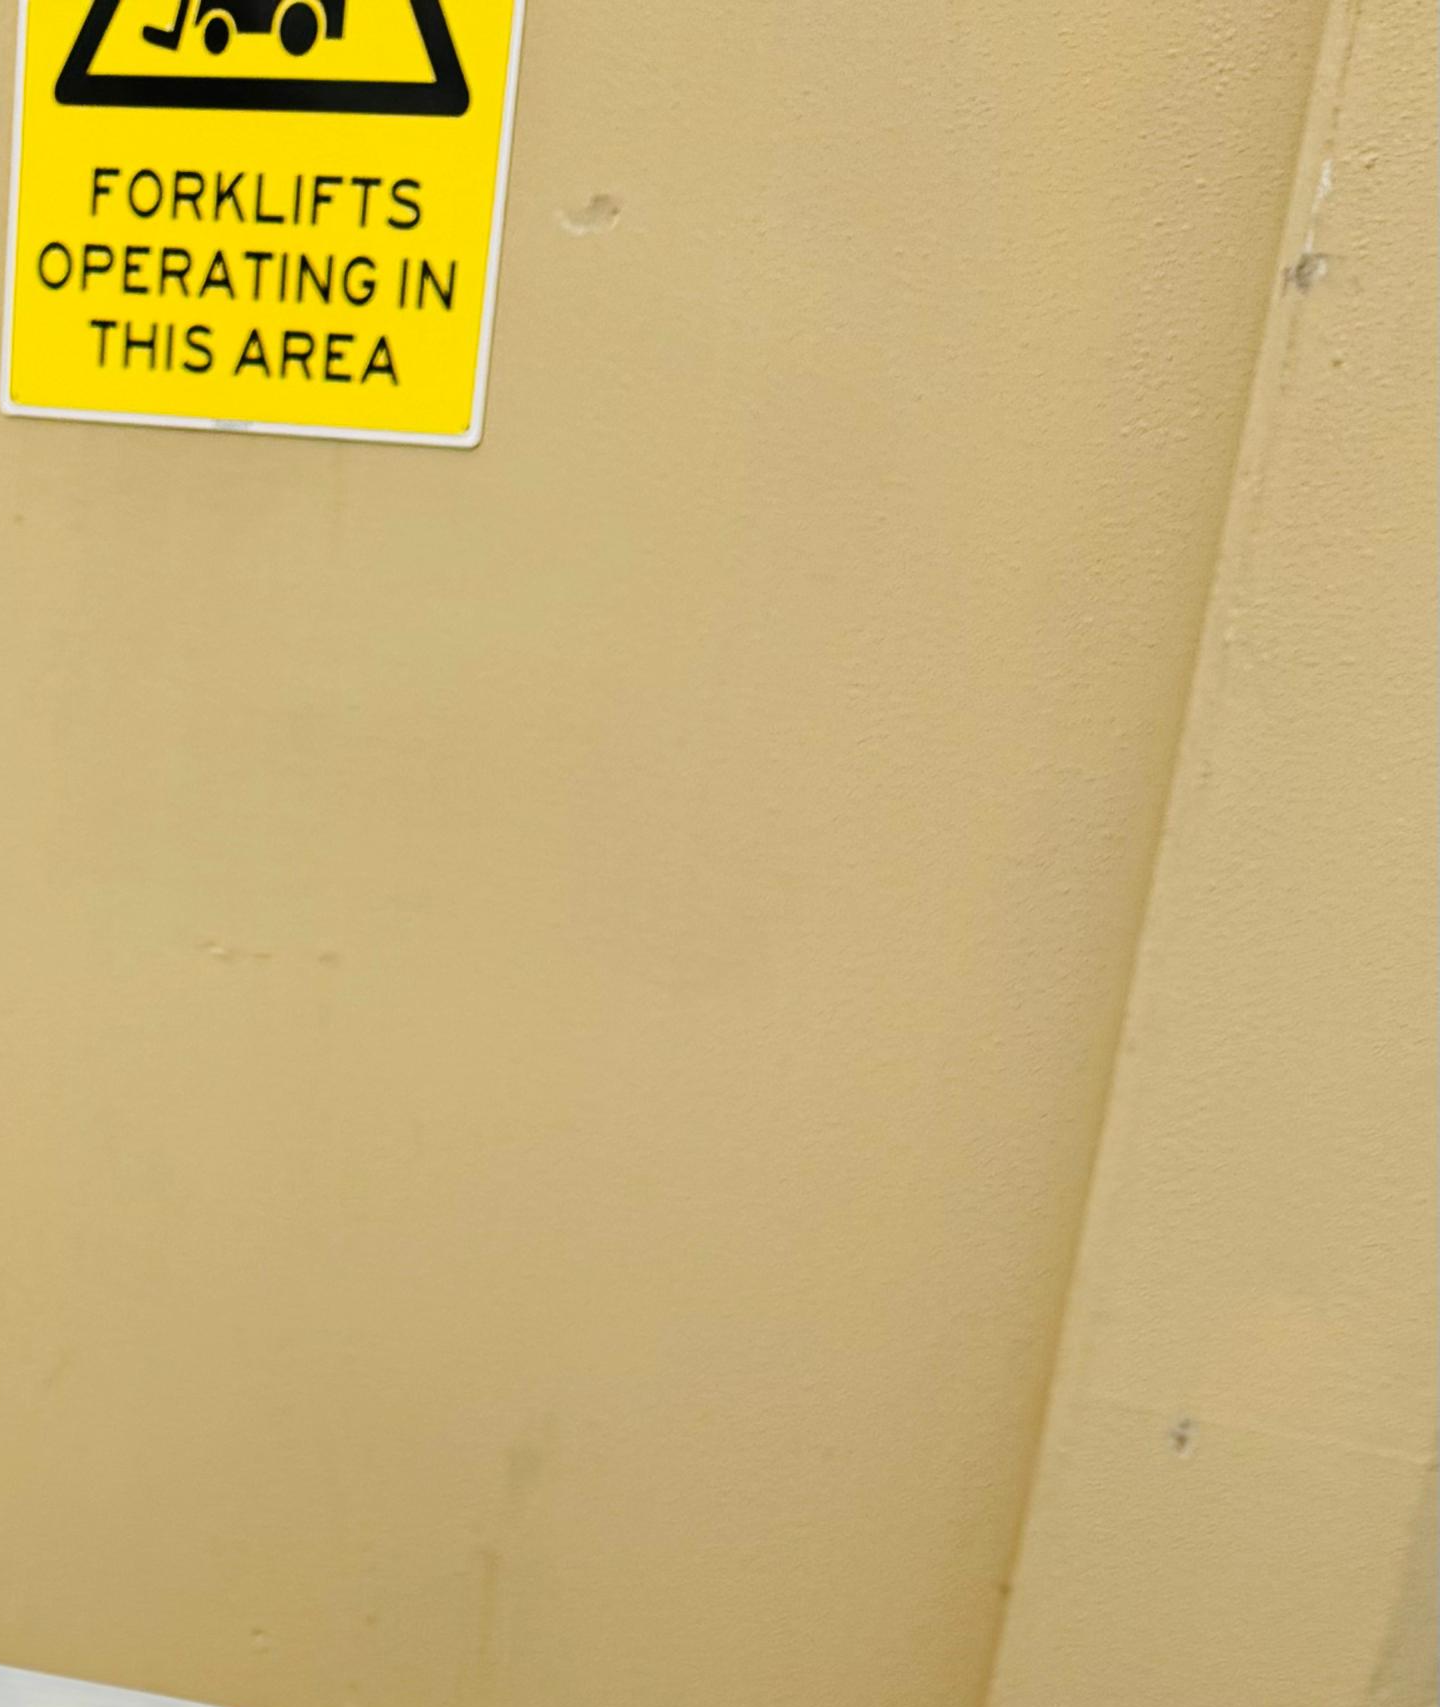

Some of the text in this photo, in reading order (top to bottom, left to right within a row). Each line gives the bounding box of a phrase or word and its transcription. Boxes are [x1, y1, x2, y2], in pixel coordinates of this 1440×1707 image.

[90, 166, 422, 230] FORKLIFTS
[37, 241, 456, 311] OPERATING IN
[90, 319, 400, 386] THIS AREA
